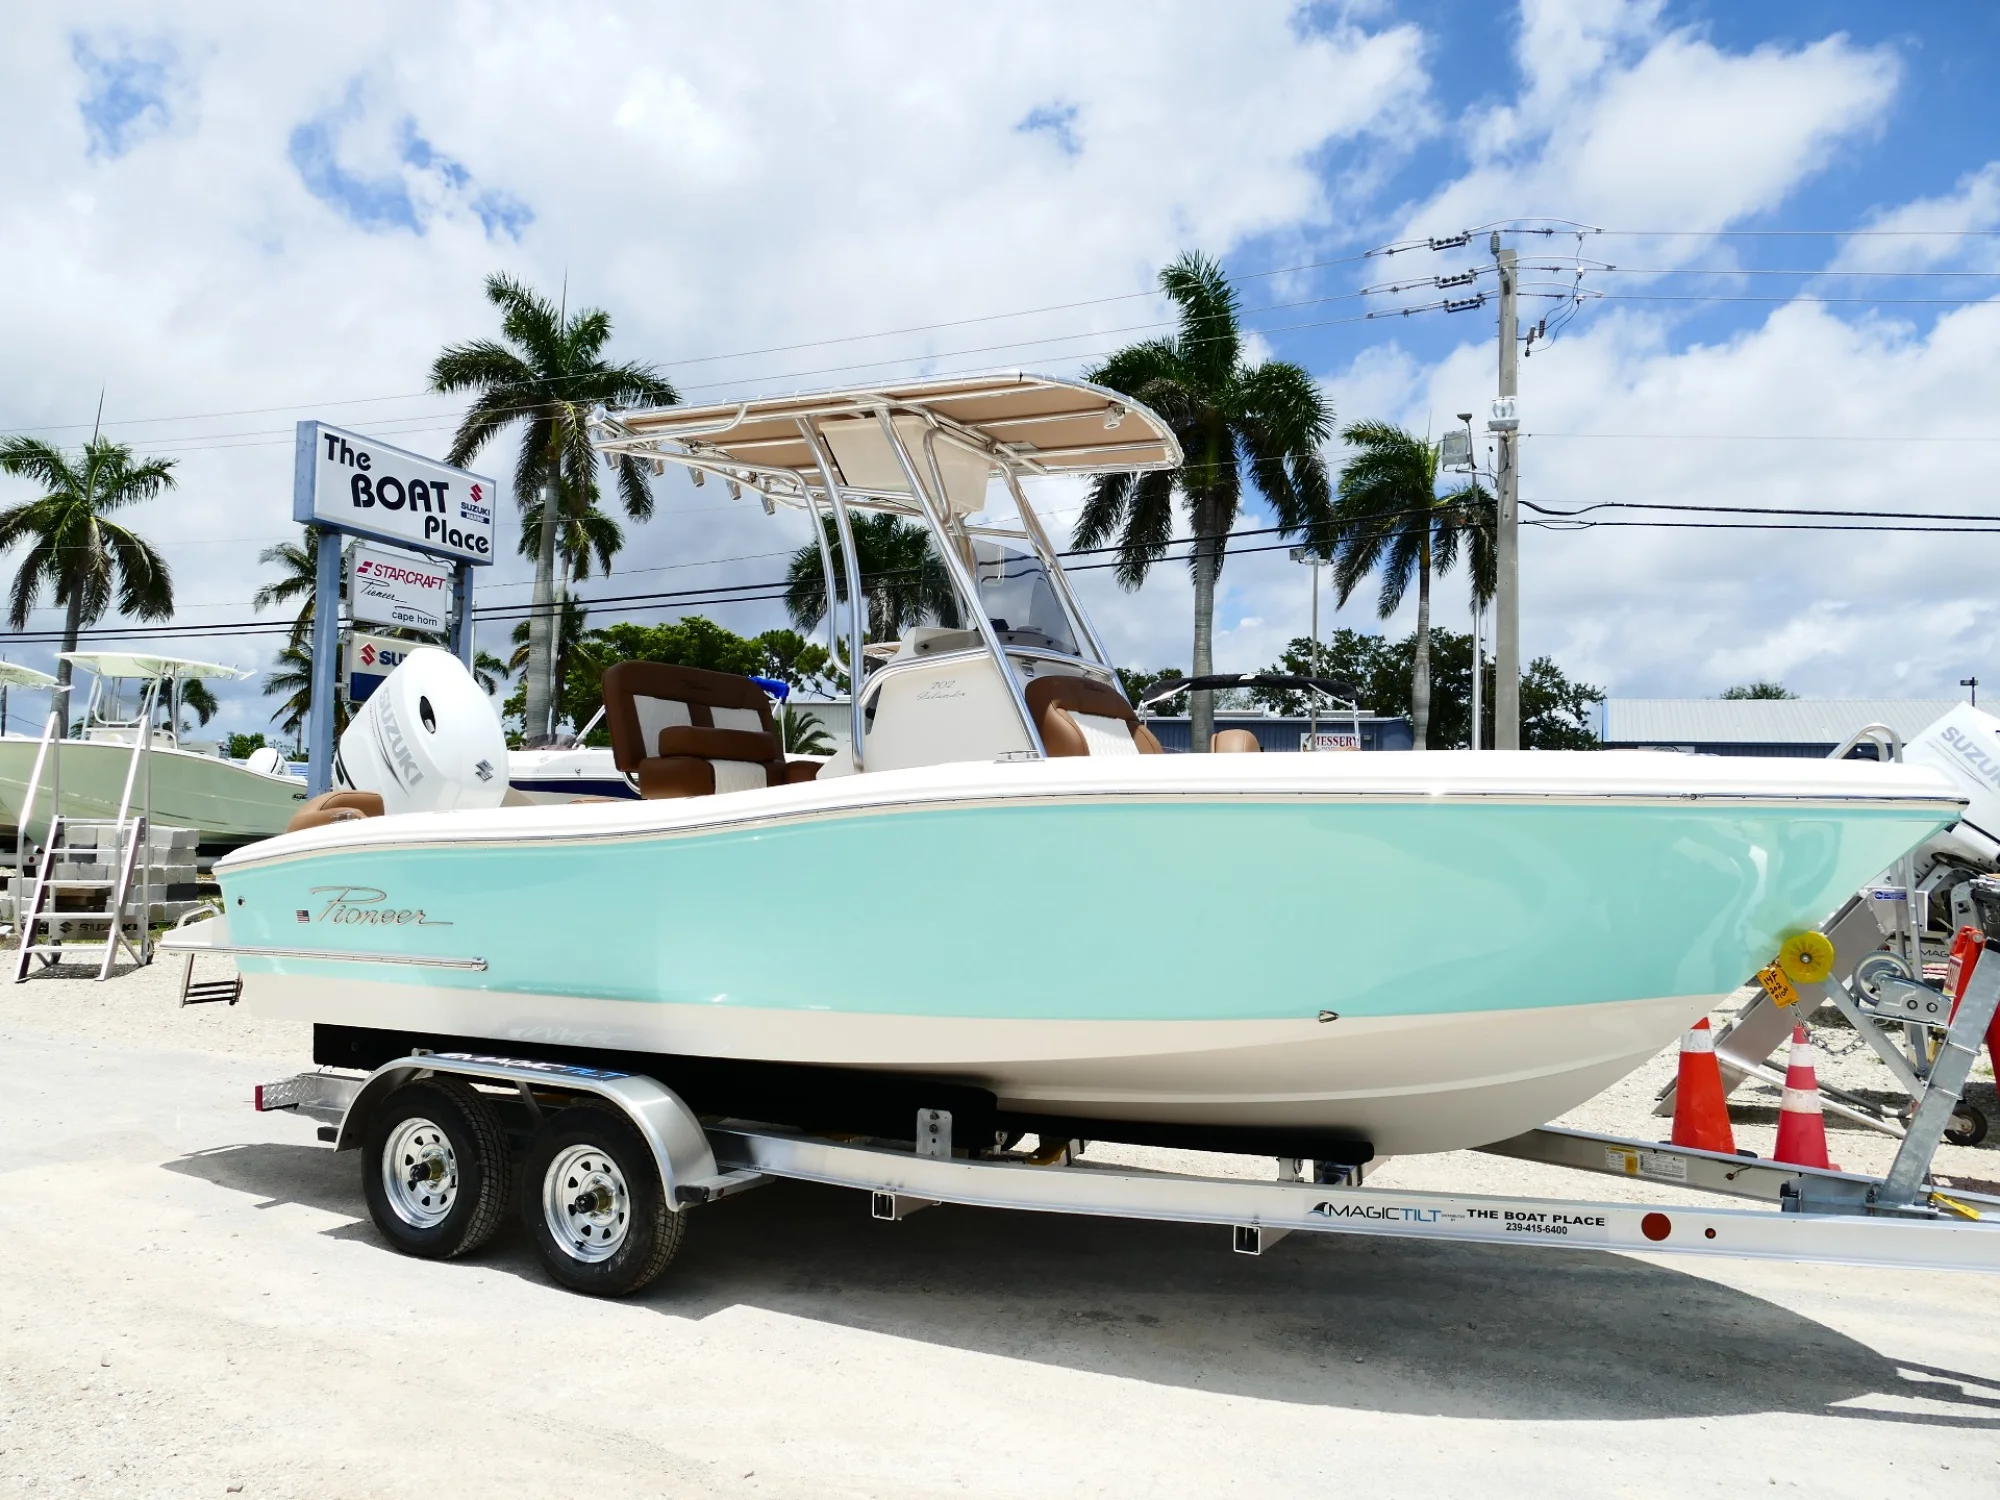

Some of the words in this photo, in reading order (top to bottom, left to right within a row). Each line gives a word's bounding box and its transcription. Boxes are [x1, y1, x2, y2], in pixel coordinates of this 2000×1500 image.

[324, 432, 372, 471] The
[350, 473, 450, 514] BOAT
[460, 501, 491, 516] SUZUKI
[424, 515, 490, 554] Place
[355, 574, 408, 603] Pioneer
[373, 564, 446, 590] STARCRAFT
[391, 611, 415, 622] cape
[417, 614, 438, 627] horn
[378, 687, 425, 786] SUZUKI
[309, 885, 454, 925] Pioneer
[79, 923, 138, 932] SUZKI
[1328, 1203, 1442, 1223] MAGICTILT
[1466, 1209, 1499, 1219] THE
[1504, 1211, 1547, 1223] BOAT
[1552, 1214, 1605, 1227] PLACE
[1505, 1222, 1568, 1235] 239-415-6400
